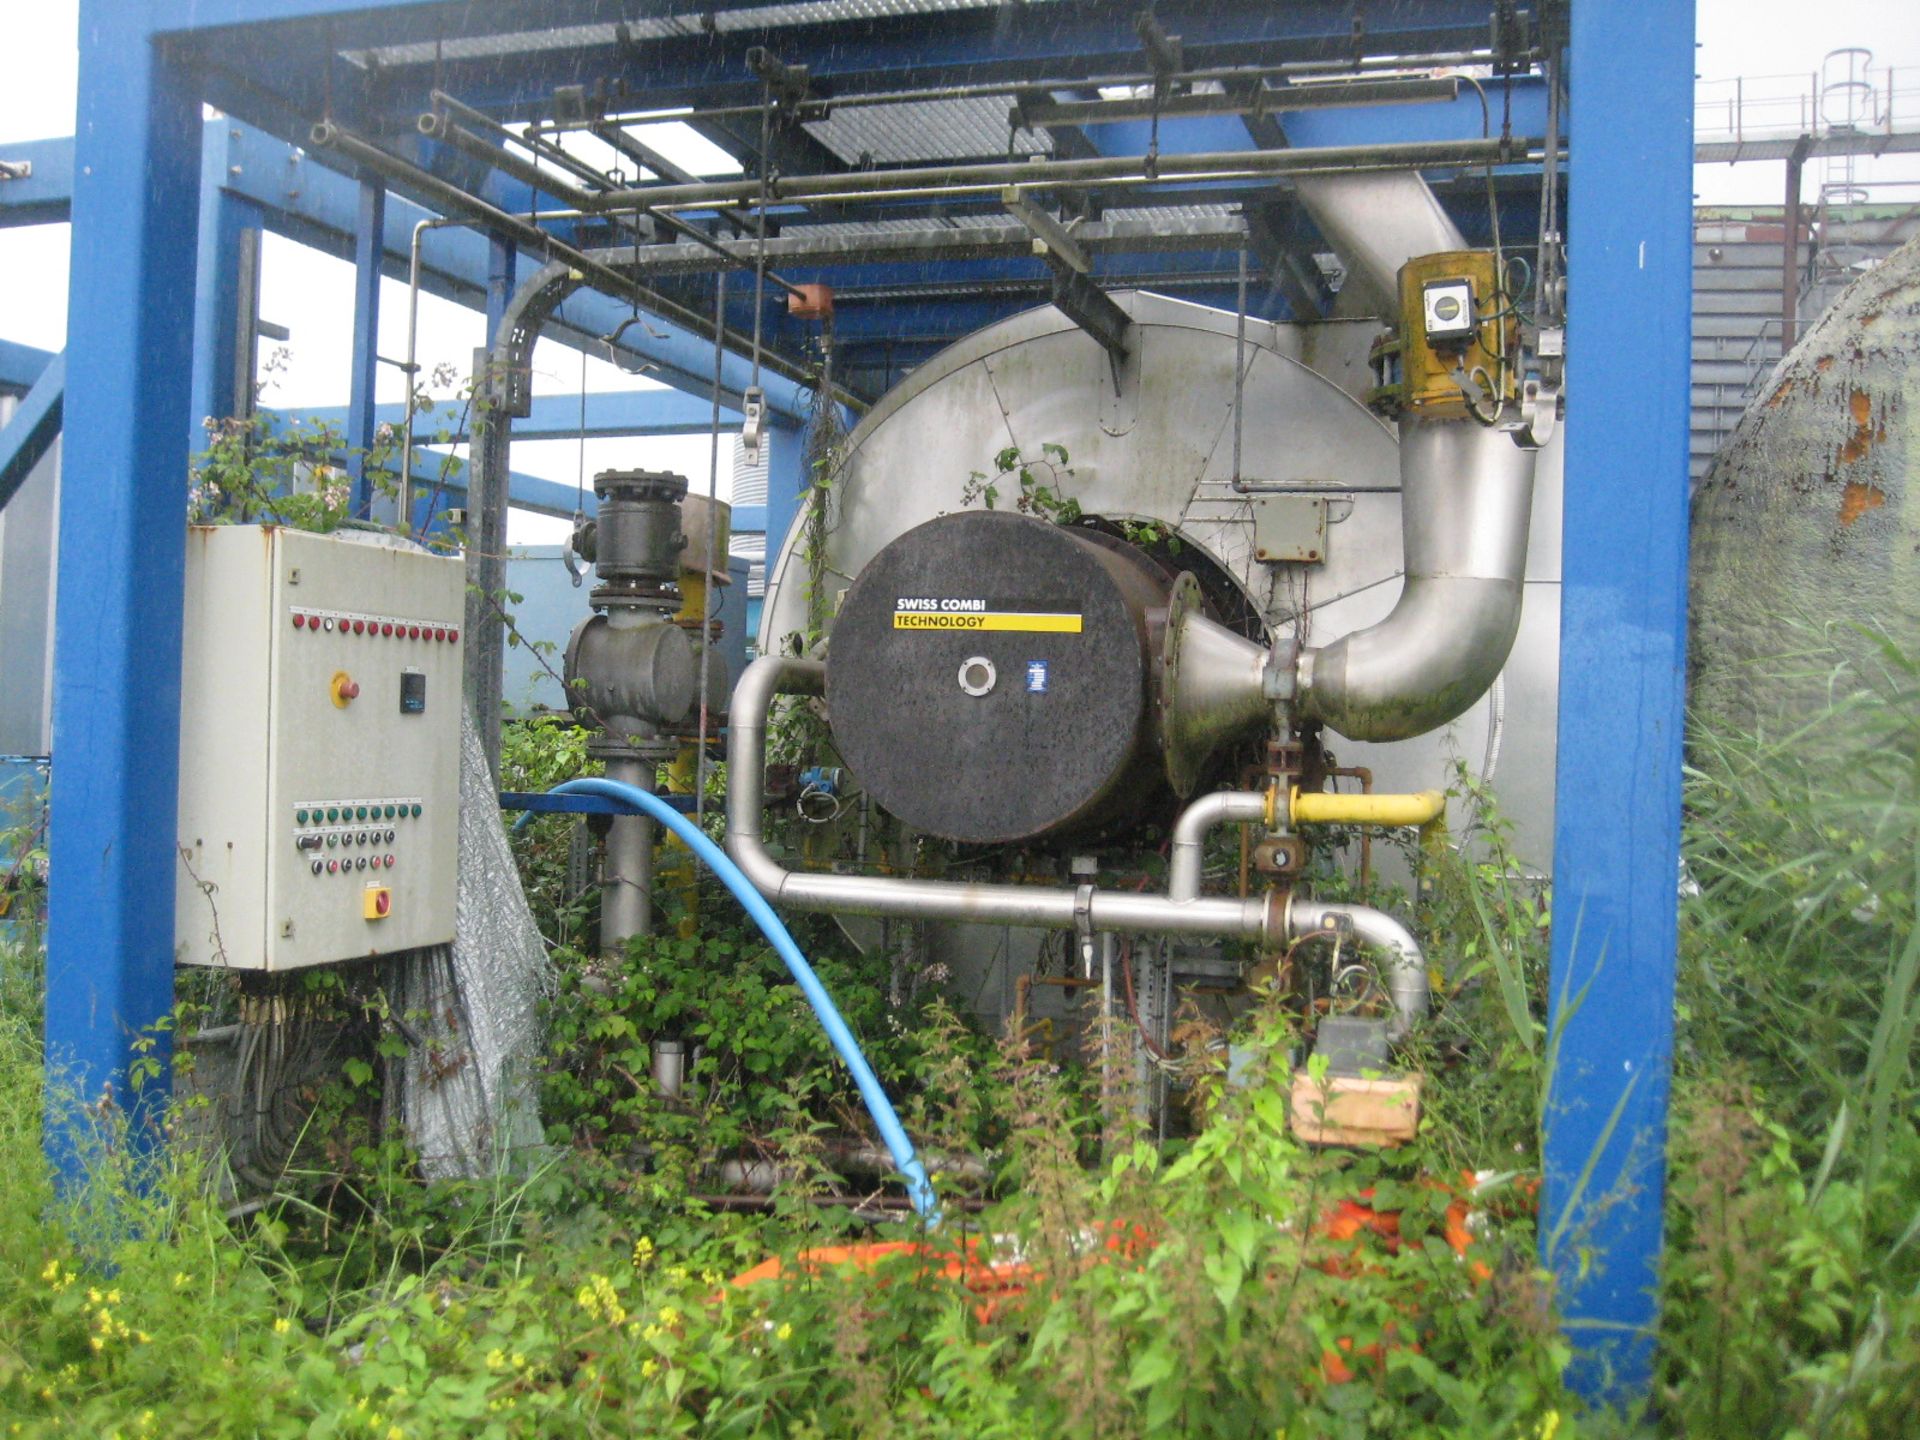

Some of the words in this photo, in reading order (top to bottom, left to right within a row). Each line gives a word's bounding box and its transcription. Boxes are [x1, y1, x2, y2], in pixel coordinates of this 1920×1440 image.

[897, 598, 938, 611] SWISS
[940, 599, 986, 611] COMBI
[897, 615, 986, 628] TECHNOLOGY
